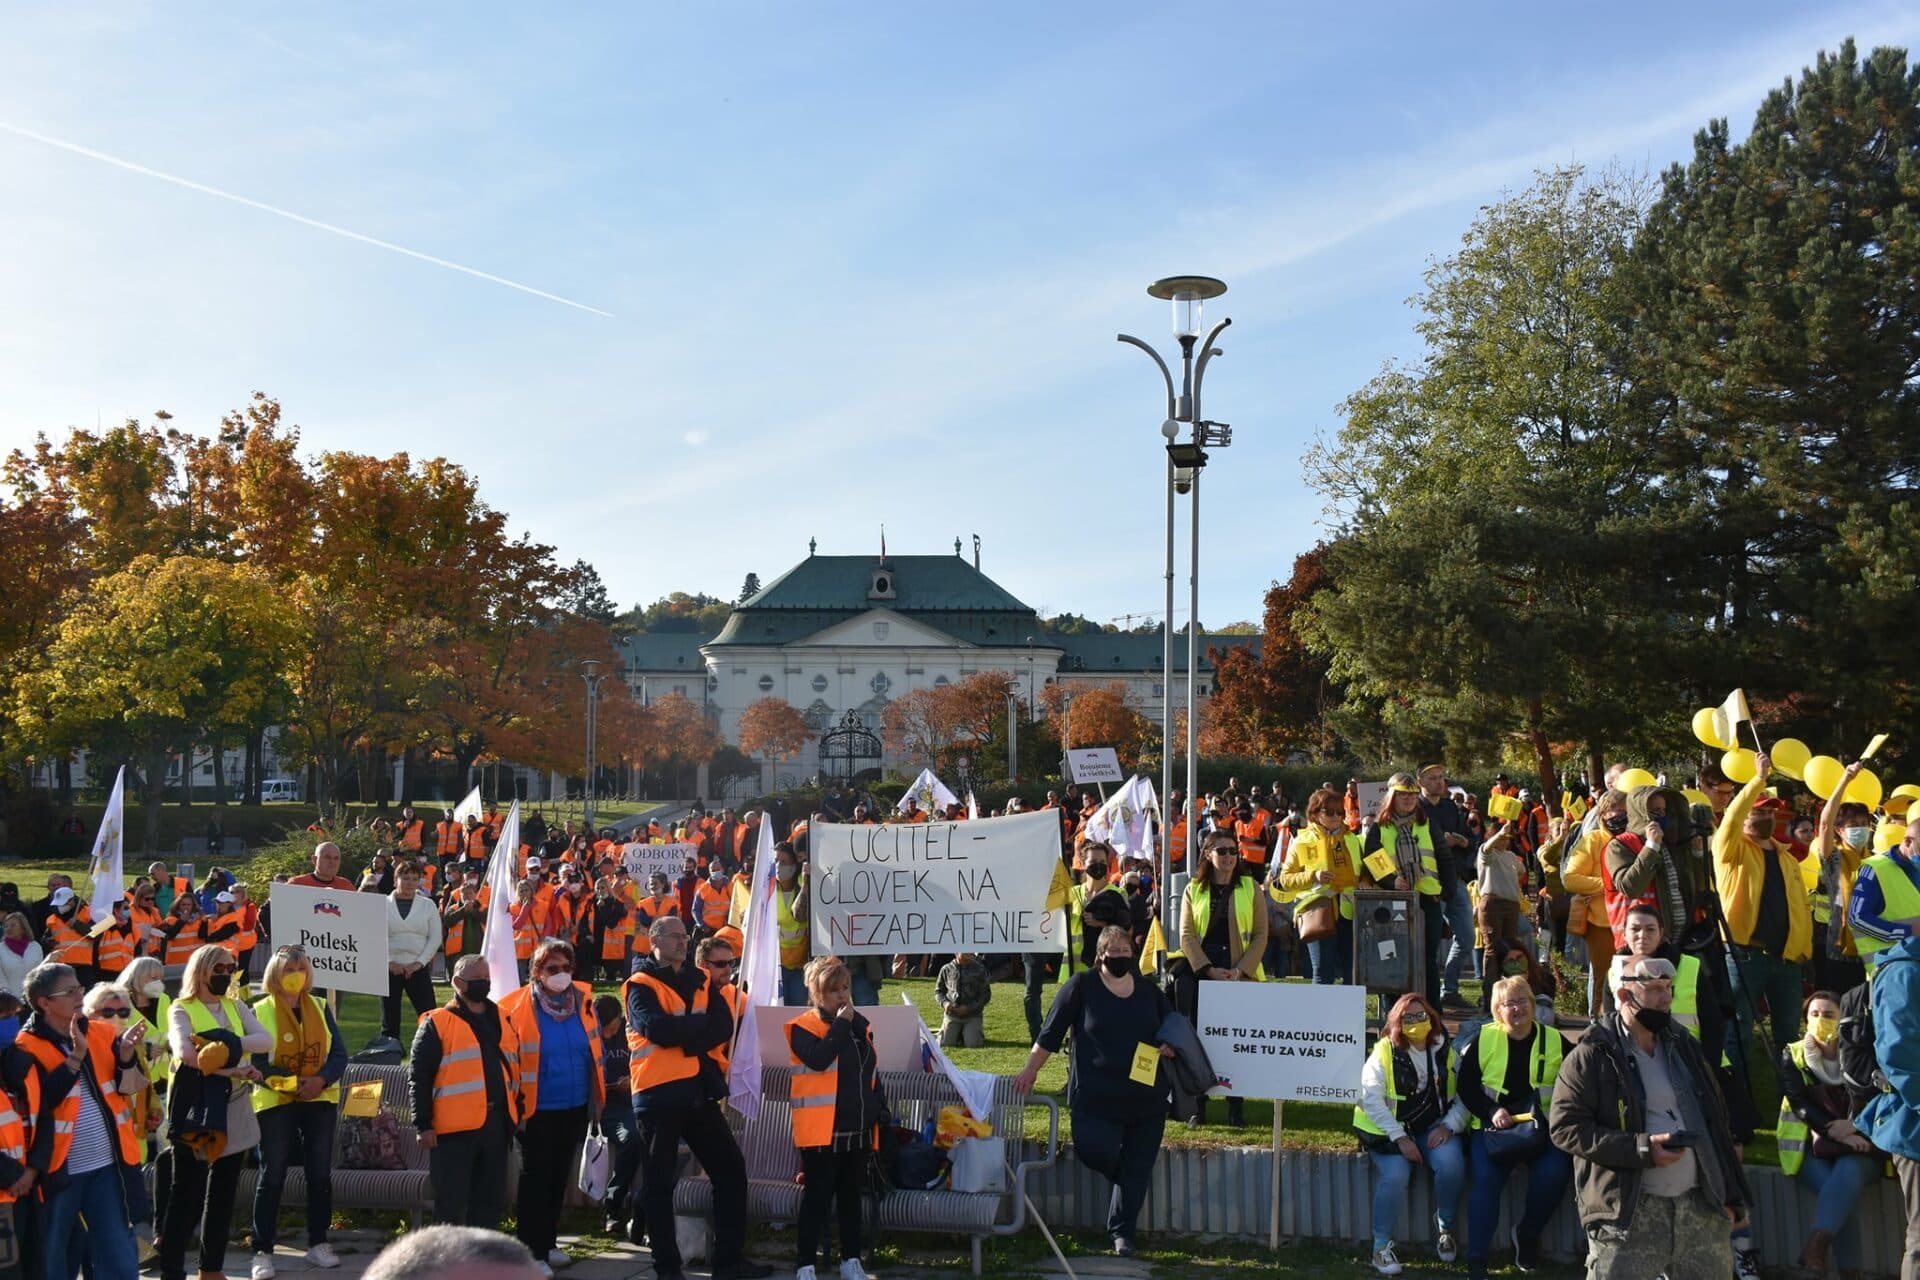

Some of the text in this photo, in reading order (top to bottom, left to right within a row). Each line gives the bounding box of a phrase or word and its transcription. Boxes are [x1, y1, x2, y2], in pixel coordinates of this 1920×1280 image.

[632, 848, 688, 860] ODBORY
[819, 865, 1001, 905] ČLOVEK NA
[300, 929, 358, 953] Potlesk
[306, 956, 358, 974] estačí
[1205, 1026, 1357, 1045] SME TU ZA PRACUJÚCICH,
[1233, 1043, 1326, 1058] SME TU ZA VÁS!
[1296, 1085, 1358, 1099] #REŠPEKT
